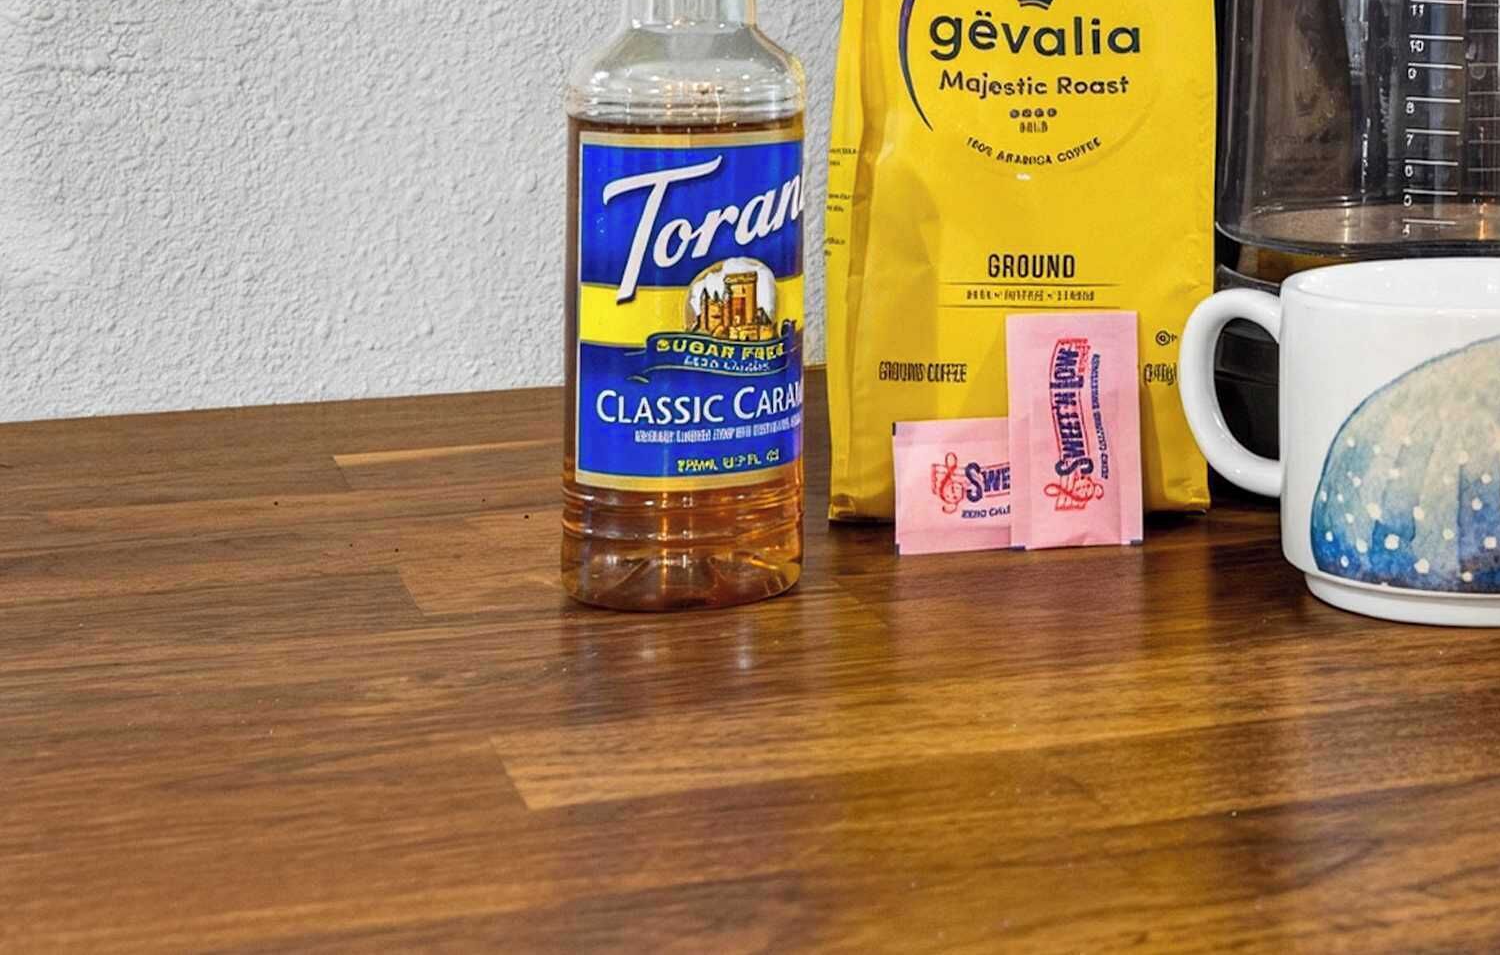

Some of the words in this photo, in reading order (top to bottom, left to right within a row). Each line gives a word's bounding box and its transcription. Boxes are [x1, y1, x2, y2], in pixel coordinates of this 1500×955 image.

[1410, 4, 1424, 17] 11
[929, 10, 1141, 61] gëvalia
[1409, 40, 1424, 53] 10
[939, 69, 1048, 100] Majestic
[1057, 76, 1130, 95] Roast
[996, 150, 1053, 165] ARABICA
[1057, 136, 1102, 163] COFFEE
[1406, 134, 1414, 147] 7
[988, 254, 1076, 279] GROUND
[656, 339, 735, 359] SUGAR
[879, 361, 925, 382] GROUND
[926, 362, 968, 383] COFFEE
[595, 389, 725, 425] CLASSIC
[964, 462, 1011, 503] SWE
